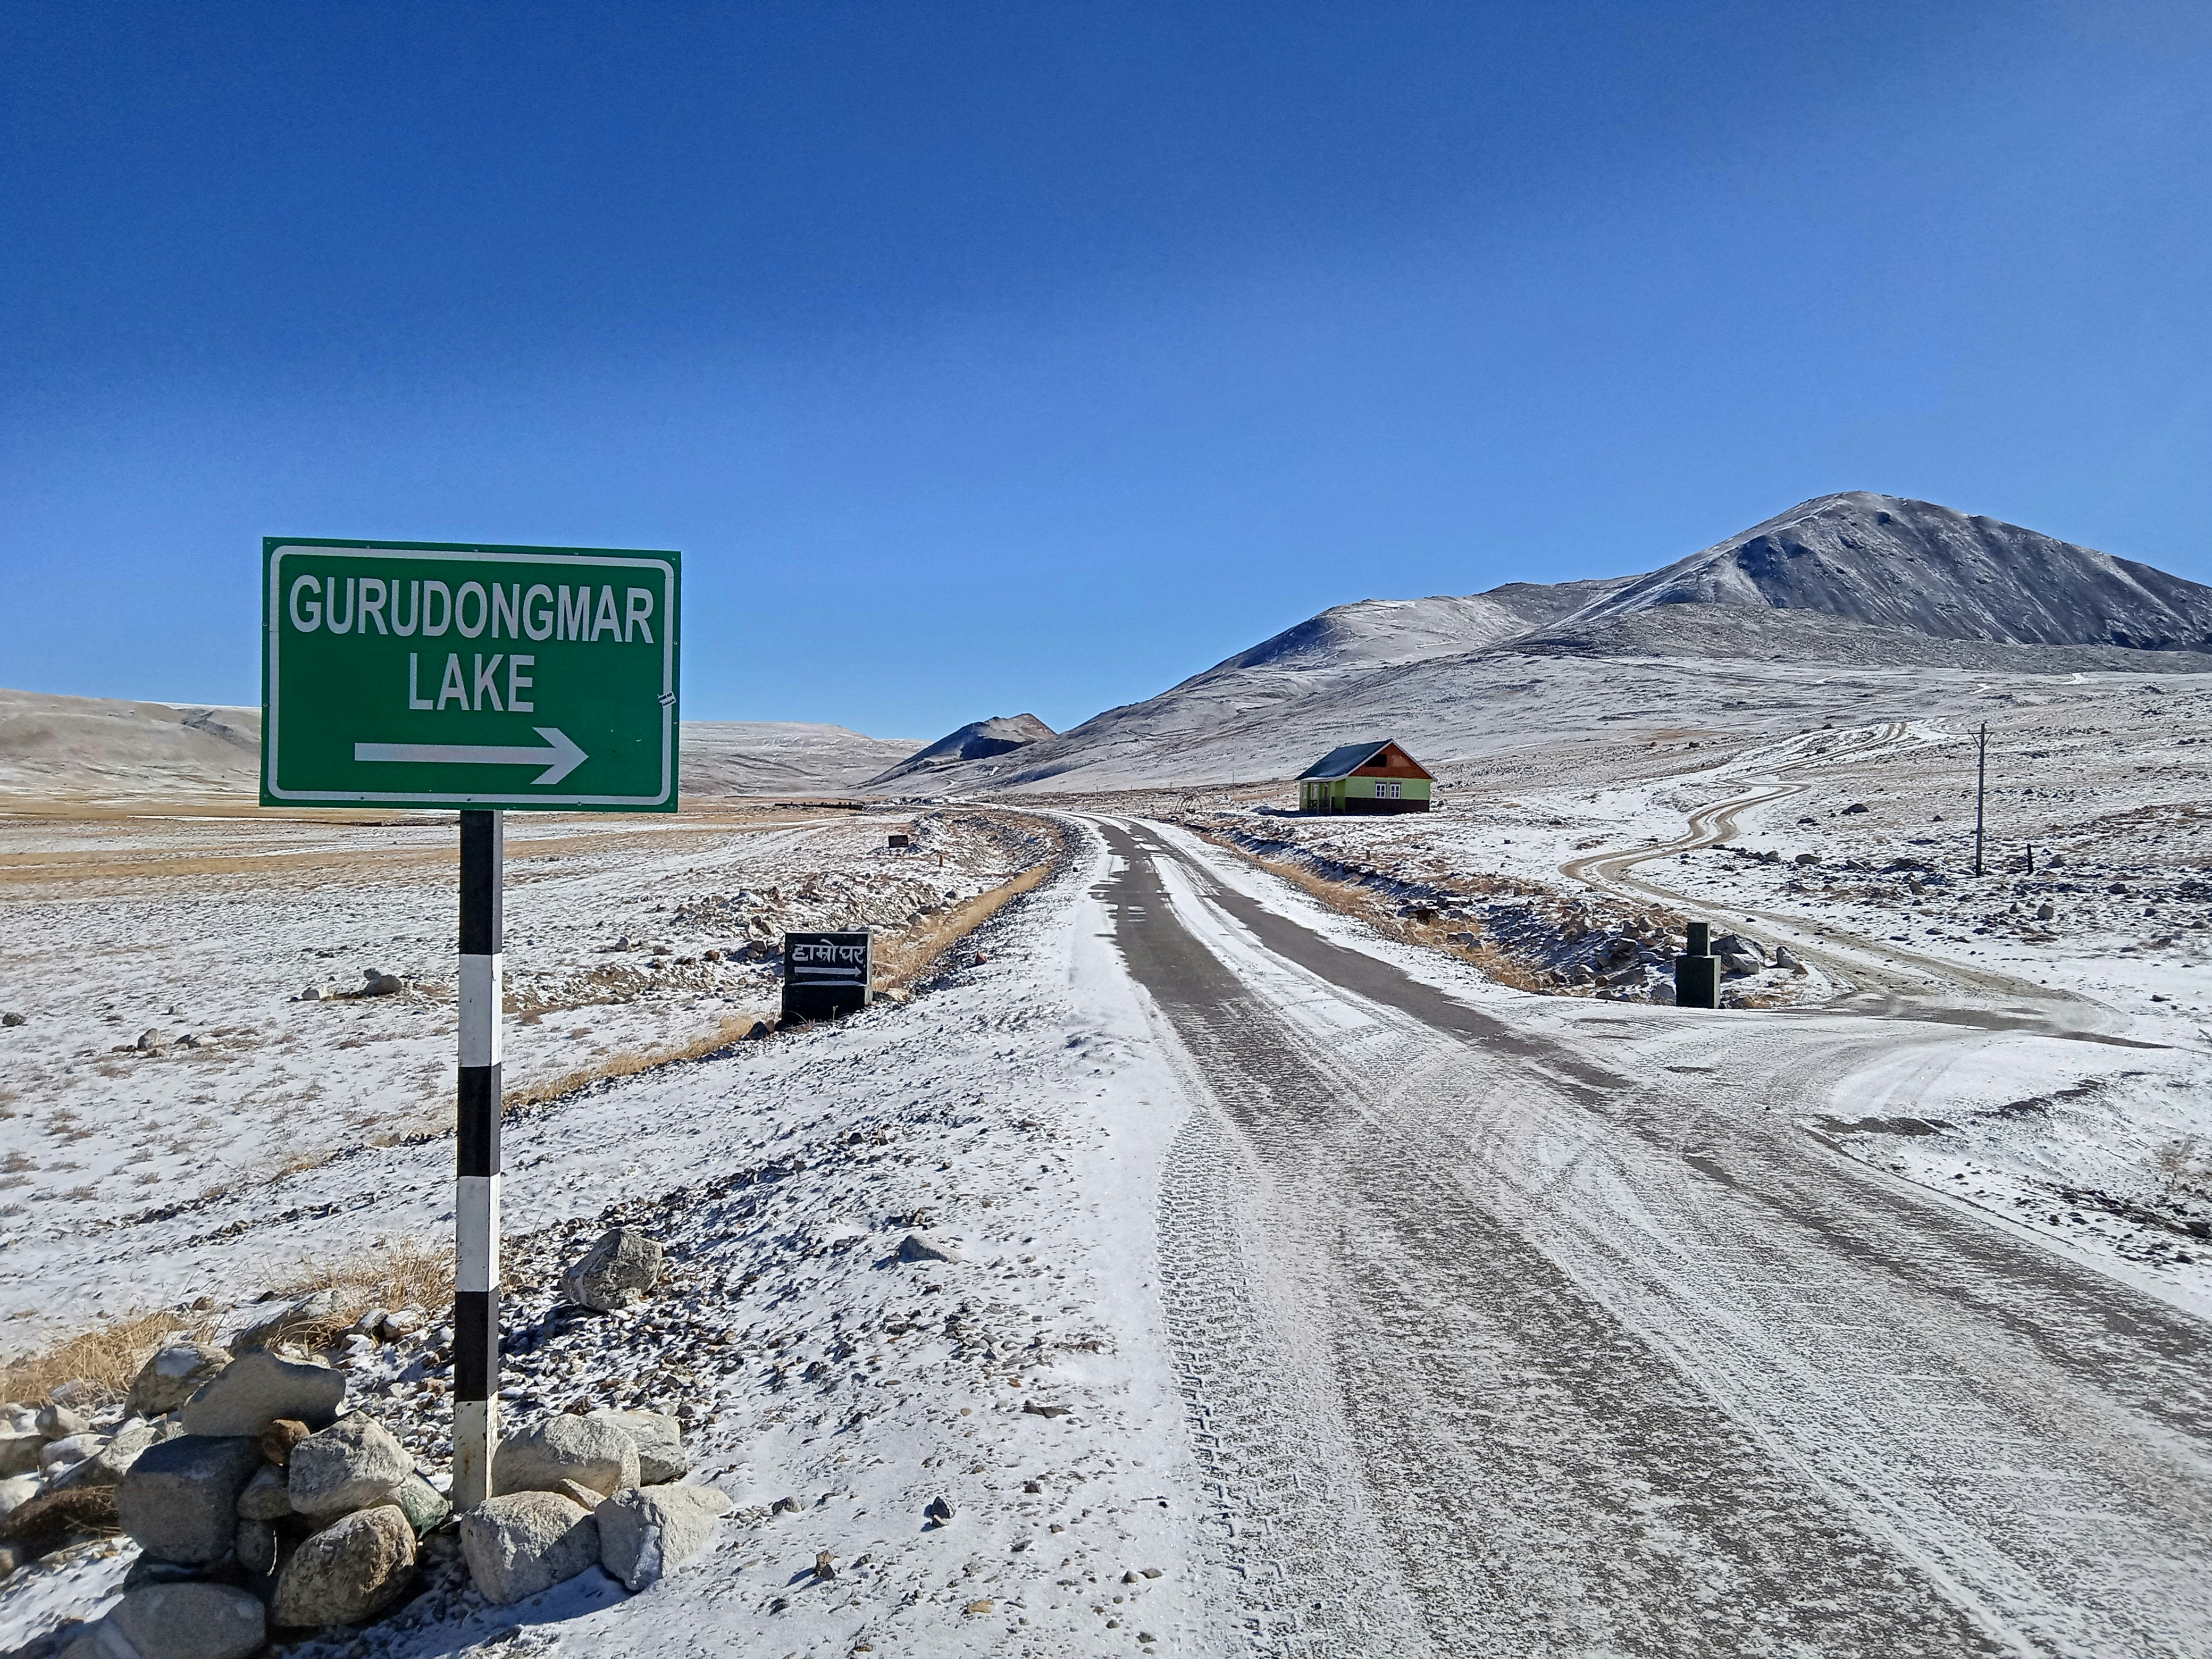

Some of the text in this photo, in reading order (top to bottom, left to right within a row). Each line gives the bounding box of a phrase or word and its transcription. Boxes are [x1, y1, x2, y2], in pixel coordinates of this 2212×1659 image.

[289, 574, 654, 644] GURUDONGMAR
[409, 652, 535, 713] LAKE
[839, 945, 866, 965] घर
